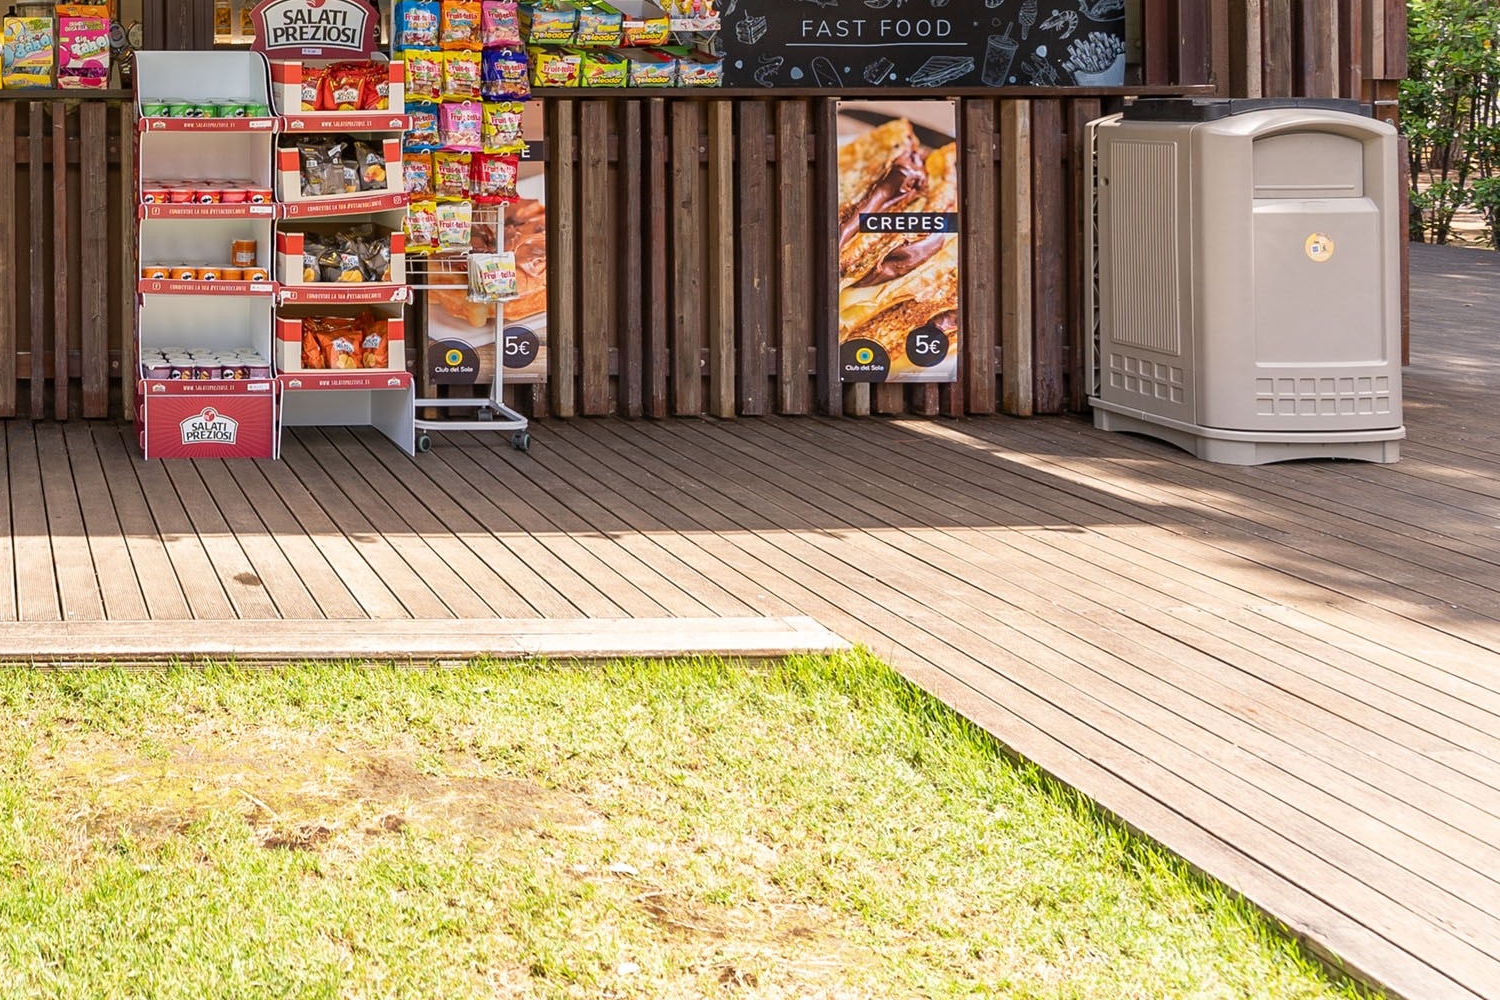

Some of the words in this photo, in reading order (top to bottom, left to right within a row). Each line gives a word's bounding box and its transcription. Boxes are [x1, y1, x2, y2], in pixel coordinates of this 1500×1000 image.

[283, 9, 348, 27] SALATI
[272, 26, 357, 44] PREZIOSI
[801, 19, 867, 37] FAST
[879, 19, 952, 37] FOOD
[866, 216, 945, 230] CREPES
[505, 336, 530, 356] 5€
[915, 335, 941, 355] 5€
[186, 431, 233, 441] PREZIOSI
[191, 422, 227, 432] SALATI
